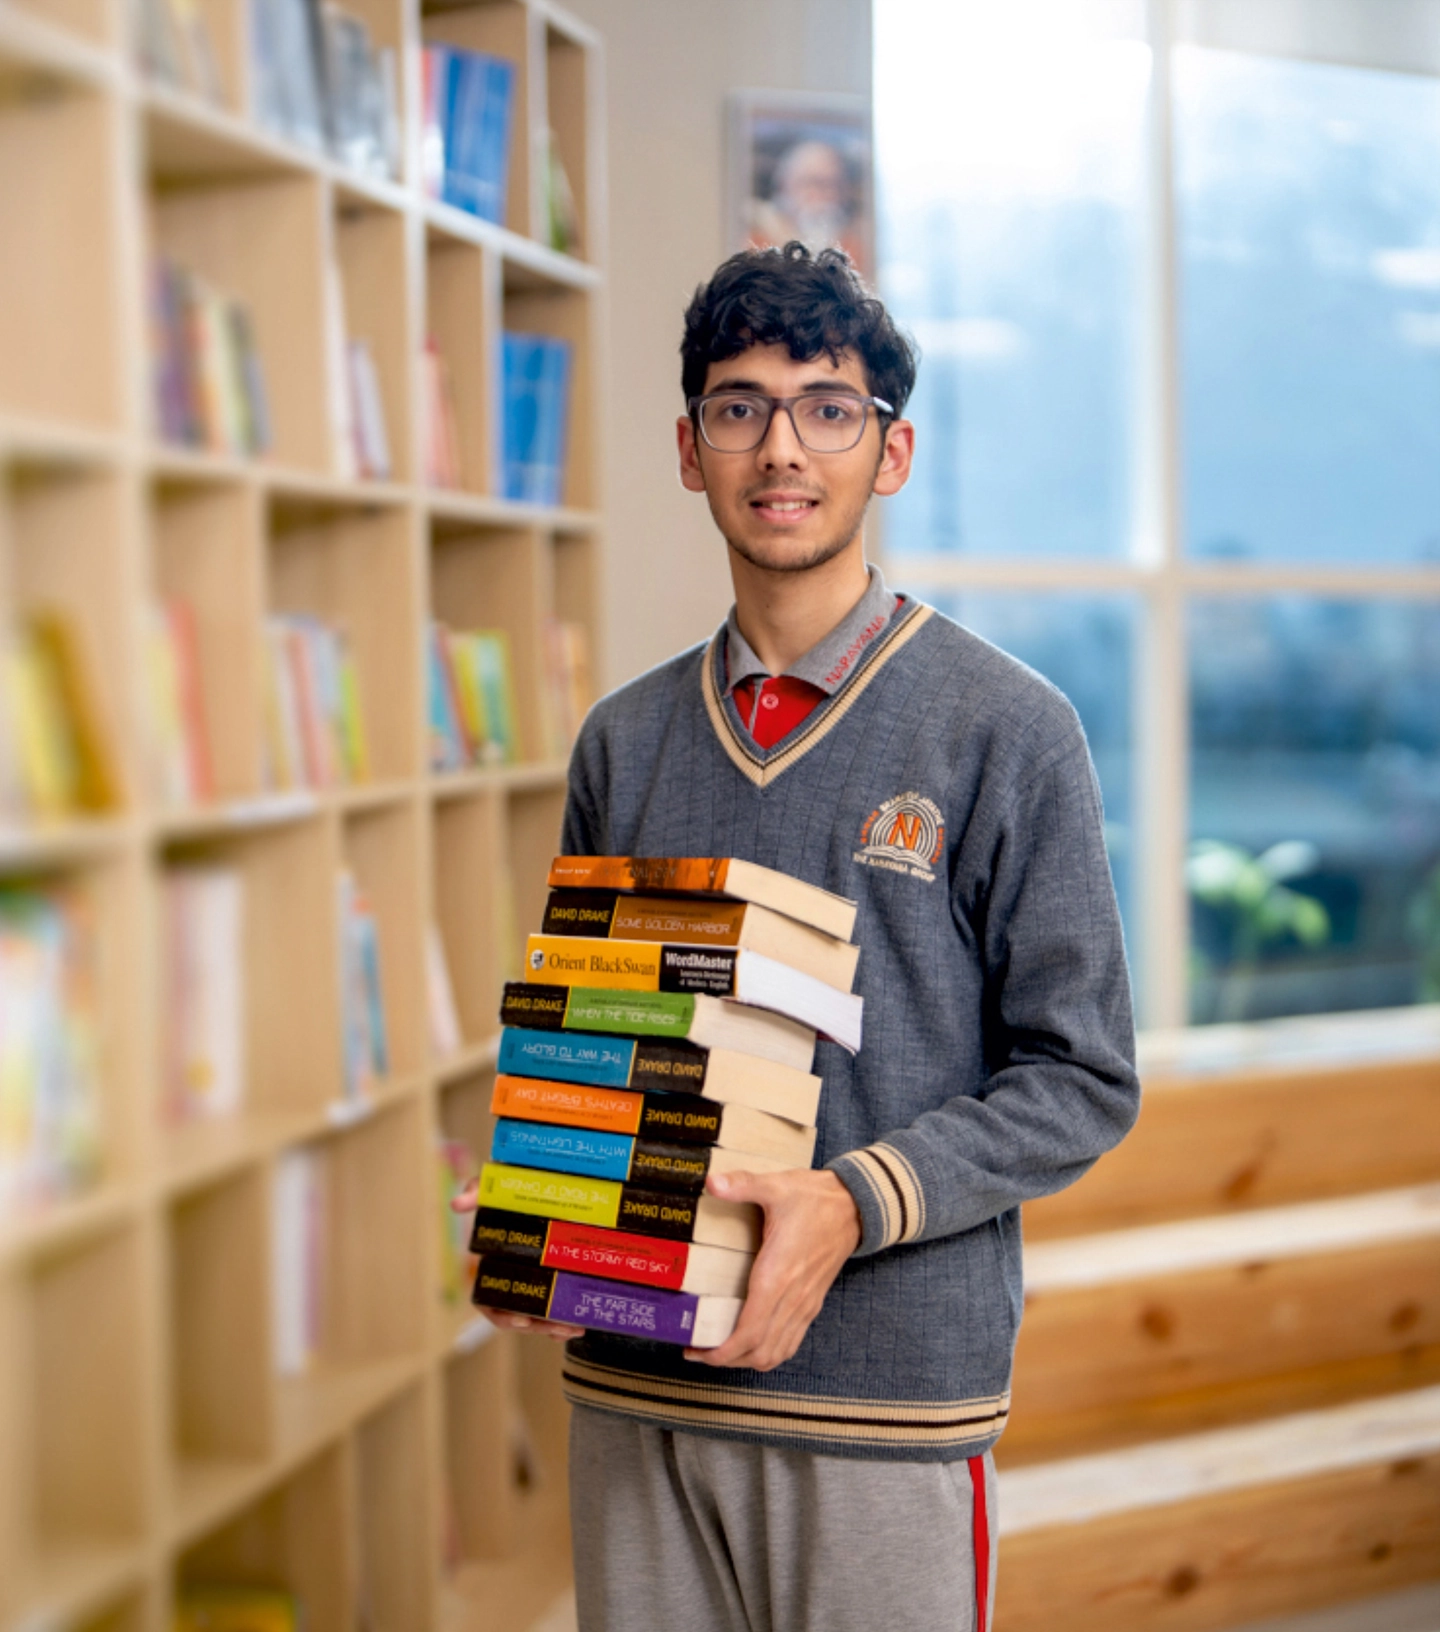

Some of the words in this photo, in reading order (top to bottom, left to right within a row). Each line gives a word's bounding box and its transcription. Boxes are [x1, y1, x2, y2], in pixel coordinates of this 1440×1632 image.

[825, 615, 886, 686] NARAYANA
[887, 812, 922, 850] N
[551, 907, 577, 920] DAVID
[578, 909, 610, 923] DRAKE
[616, 917, 642, 929] SOME
[645, 919, 685, 932] GOLDEN
[687, 922, 731, 934] HARBOR
[549, 953, 586, 972] Orient
[590, 956, 656, 976] BlackSwan
[665, 951, 732, 970] WordMaster
[505, 996, 532, 1009] DAVID
[532, 998, 563, 1012] DRAKE
[571, 1008, 601, 1020] WHEN
[604, 1009, 623, 1021] THE
[625, 1010, 646, 1023] TIDE
[647, 1011, 676, 1025] RISES
[521, 1043, 557, 1055] GLORY
[559, 1046, 574, 1058] TO
[575, 1047, 598, 1060] WAY
[602, 1050, 621, 1063] THE
[637, 1058, 671, 1074] DRAKE
[673, 1063, 703, 1078] DAVID
[514, 1089, 537, 1099] DAY
[544, 1091, 581, 1107] BRIGHT
[584, 1095, 633, 1113] DEATH'S
[645, 1109, 682, 1125] DRAKE
[684, 1113, 717, 1130] DAVID
[510, 1130, 572, 1147] LIGHTNINGS
[576, 1140, 595, 1152] THE
[597, 1143, 627, 1157] WITH
[636, 1153, 673, 1168] DRAKE
[674, 1159, 705, 1175] DAVID
[500, 1178, 541, 1192] DANGER
[543, 1182, 558, 1195] OF
[559, 1186, 588, 1201] ROAD
[590, 1190, 609, 1204] THE
[623, 1201, 659, 1218] DRAKE
[660, 1207, 691, 1224] DAVID
[477, 1226, 505, 1241] DAVID
[506, 1231, 542, 1247] DRAKE
[549, 1244, 559, 1256] IN
[561, 1245, 580, 1258] THE
[583, 1249, 624, 1265] STORMY
[625, 1256, 647, 1270] RED
[649, 1260, 670, 1275] SKY
[480, 1275, 510, 1292] DAVID
[512, 1281, 547, 1298] DRAKE
[580, 1293, 602, 1308] THE
[603, 1296, 627, 1312] FAR
[630, 1302, 656, 1317] SIDE
[574, 1306, 589, 1318] OF
[593, 1309, 614, 1324] THE
[618, 1312, 656, 1331] STARS
